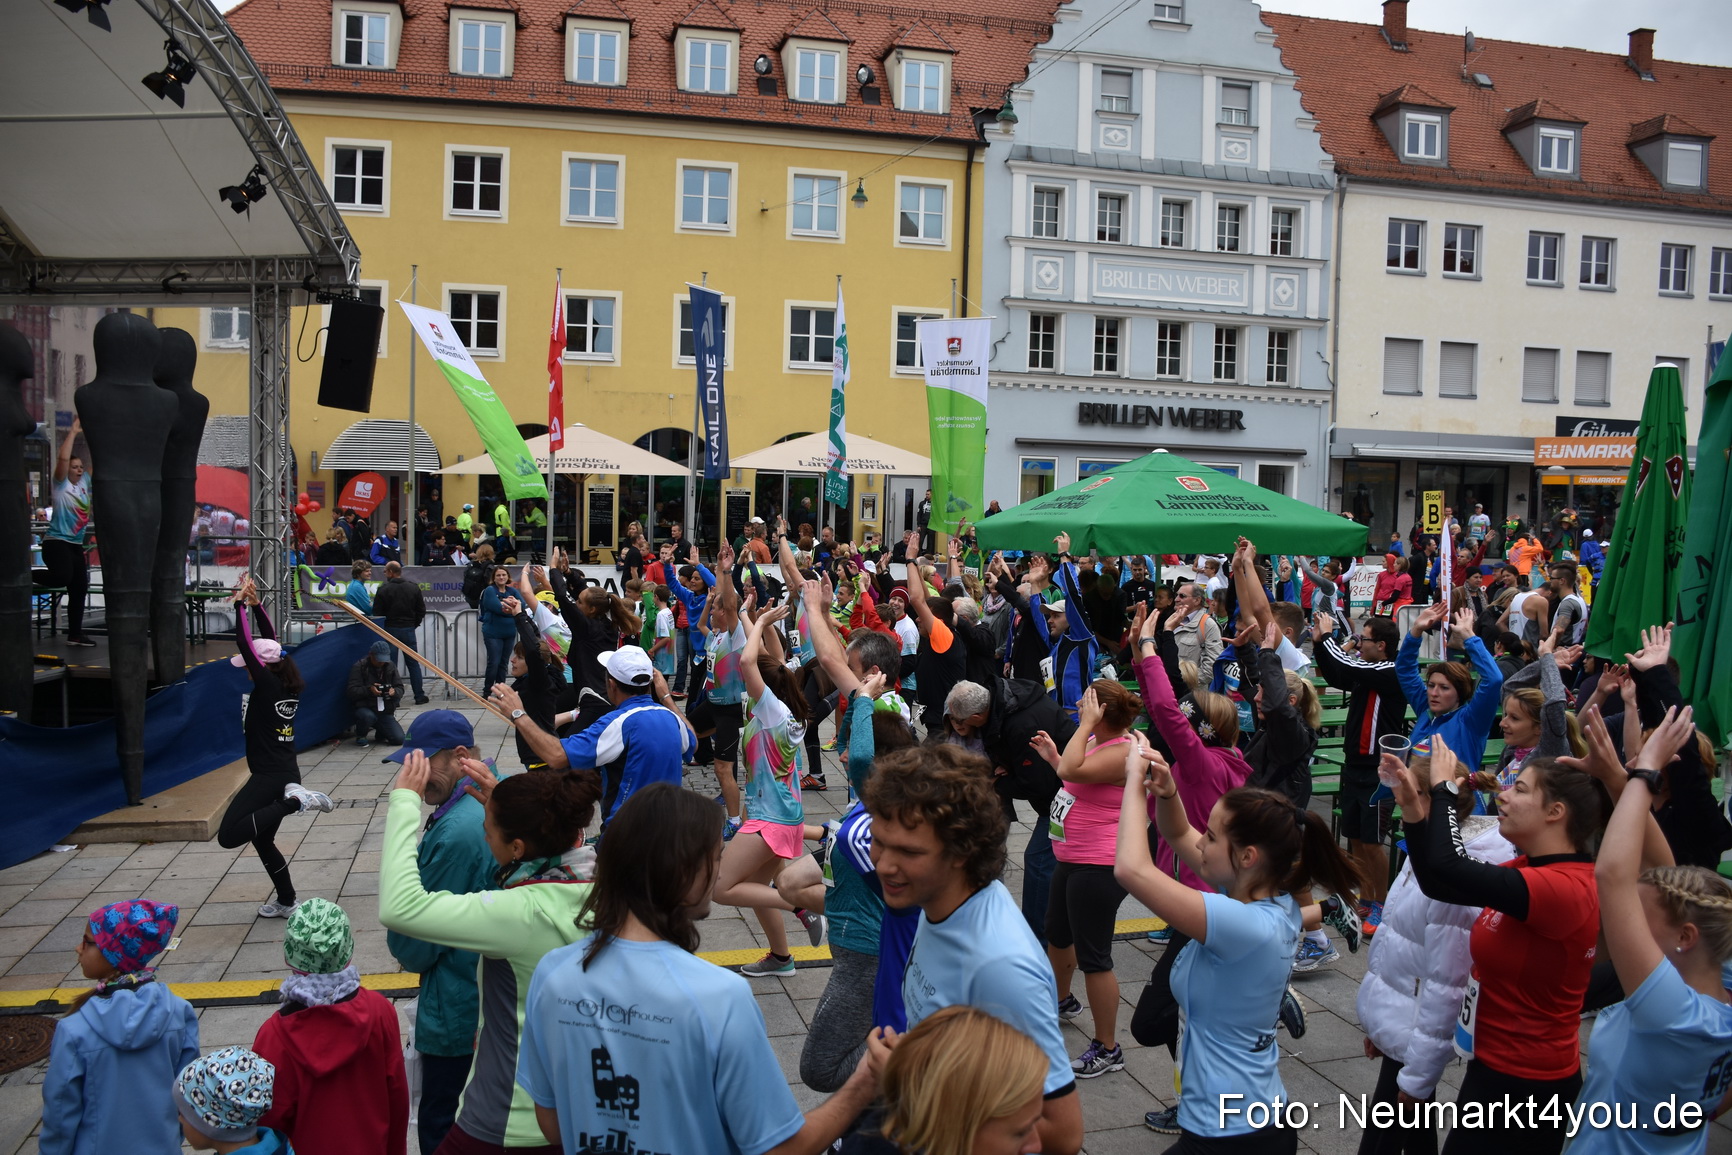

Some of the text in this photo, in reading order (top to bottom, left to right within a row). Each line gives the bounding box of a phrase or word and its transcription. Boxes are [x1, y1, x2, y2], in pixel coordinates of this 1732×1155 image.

[1102, 269, 1240, 296] BRILLEN WEBER
[1078, 402, 1247, 430] BRILLEN WEBER
[1165, 494, 1245, 502] Neumarkter
[1425, 492, 1442, 501] Block
[1154, 499, 1270, 511] Lammsbräu
[1428, 503, 1440, 525] B
[311, 582, 381, 595] BOK
